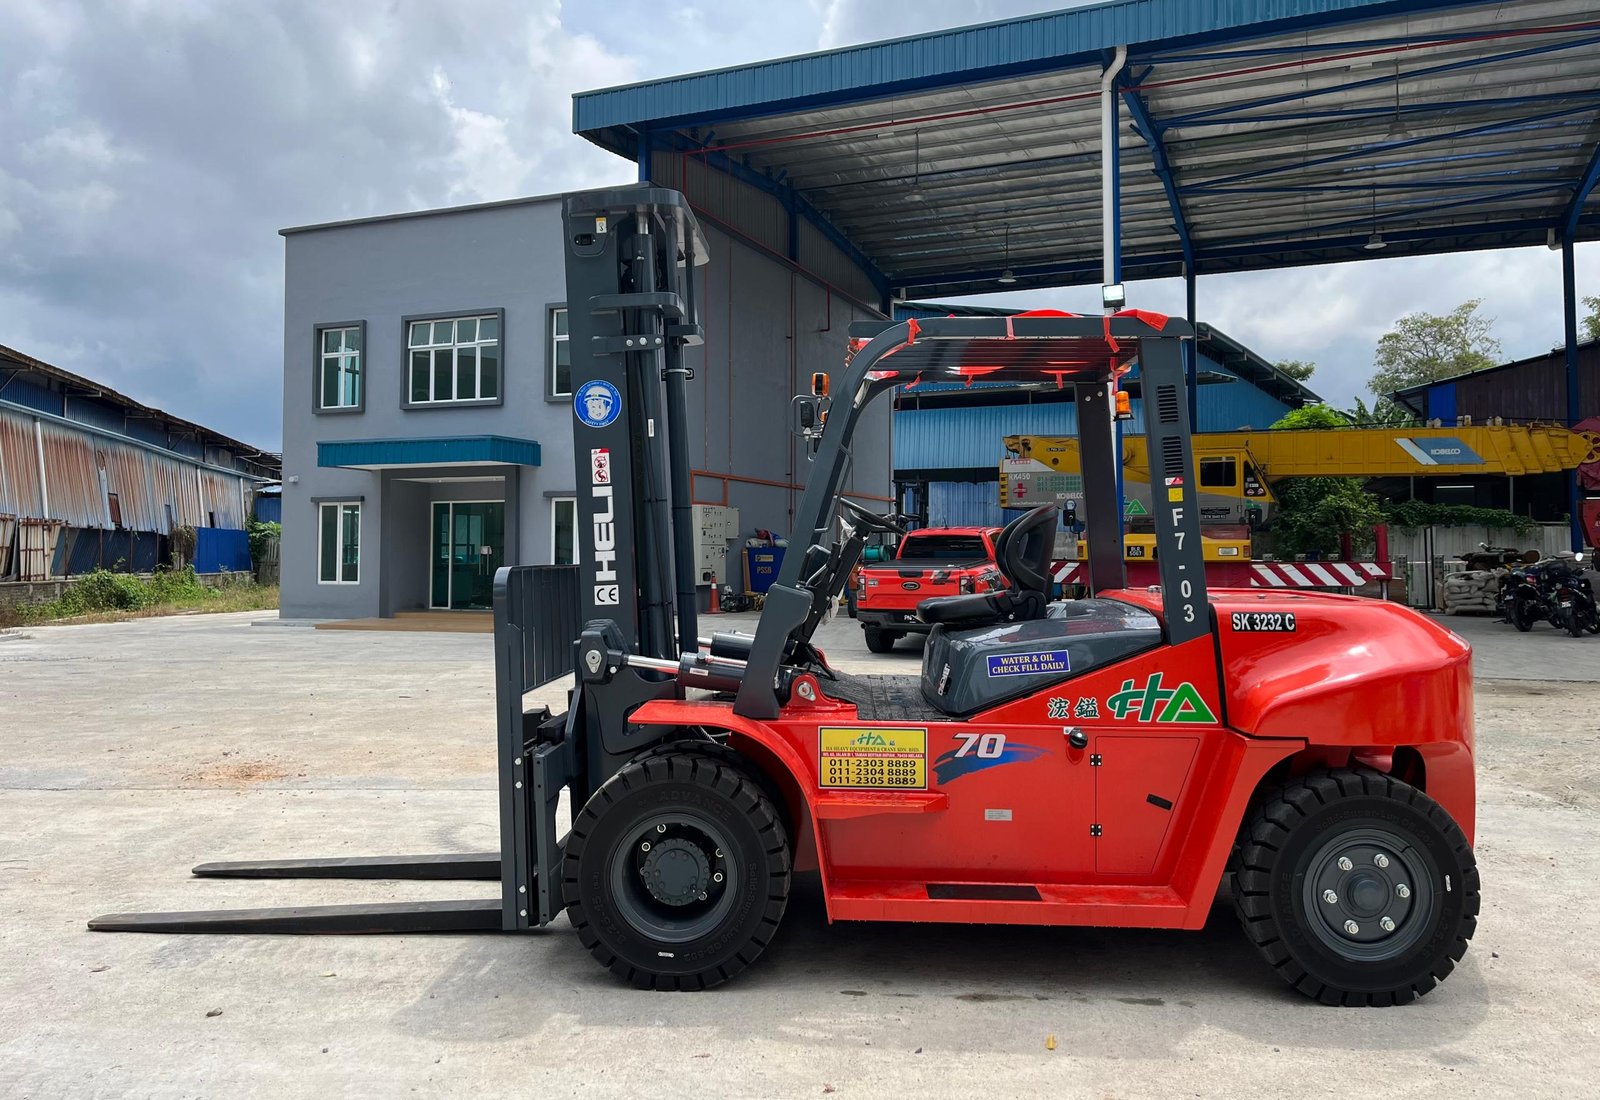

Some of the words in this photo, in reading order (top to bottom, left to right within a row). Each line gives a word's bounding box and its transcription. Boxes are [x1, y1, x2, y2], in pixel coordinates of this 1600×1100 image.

[1008, 472, 1031, 480] RK450
[592, 485, 616, 581] HELI
[1232, 613, 1251, 630] SK
[1253, 613, 1283, 630] 3232
[1285, 613, 1295, 630] C
[1001, 655, 1031, 665] WATER
[1031, 655, 1039, 663] &
[1040, 653, 1055, 662] OIL
[992, 664, 1020, 674] CHECK
[1021, 663, 1040, 672] FILL
[1041, 661, 1065, 670] DAILY
[952, 732, 1006, 758] 70
[829, 759, 884, 767] 011-2303
[887, 759, 916, 767] 8889
[887, 768, 916, 776] 8889
[829, 776, 884, 784] 011-2305
[887, 777, 916, 785] 8889
[658, 791, 732, 823] ADVANCE
